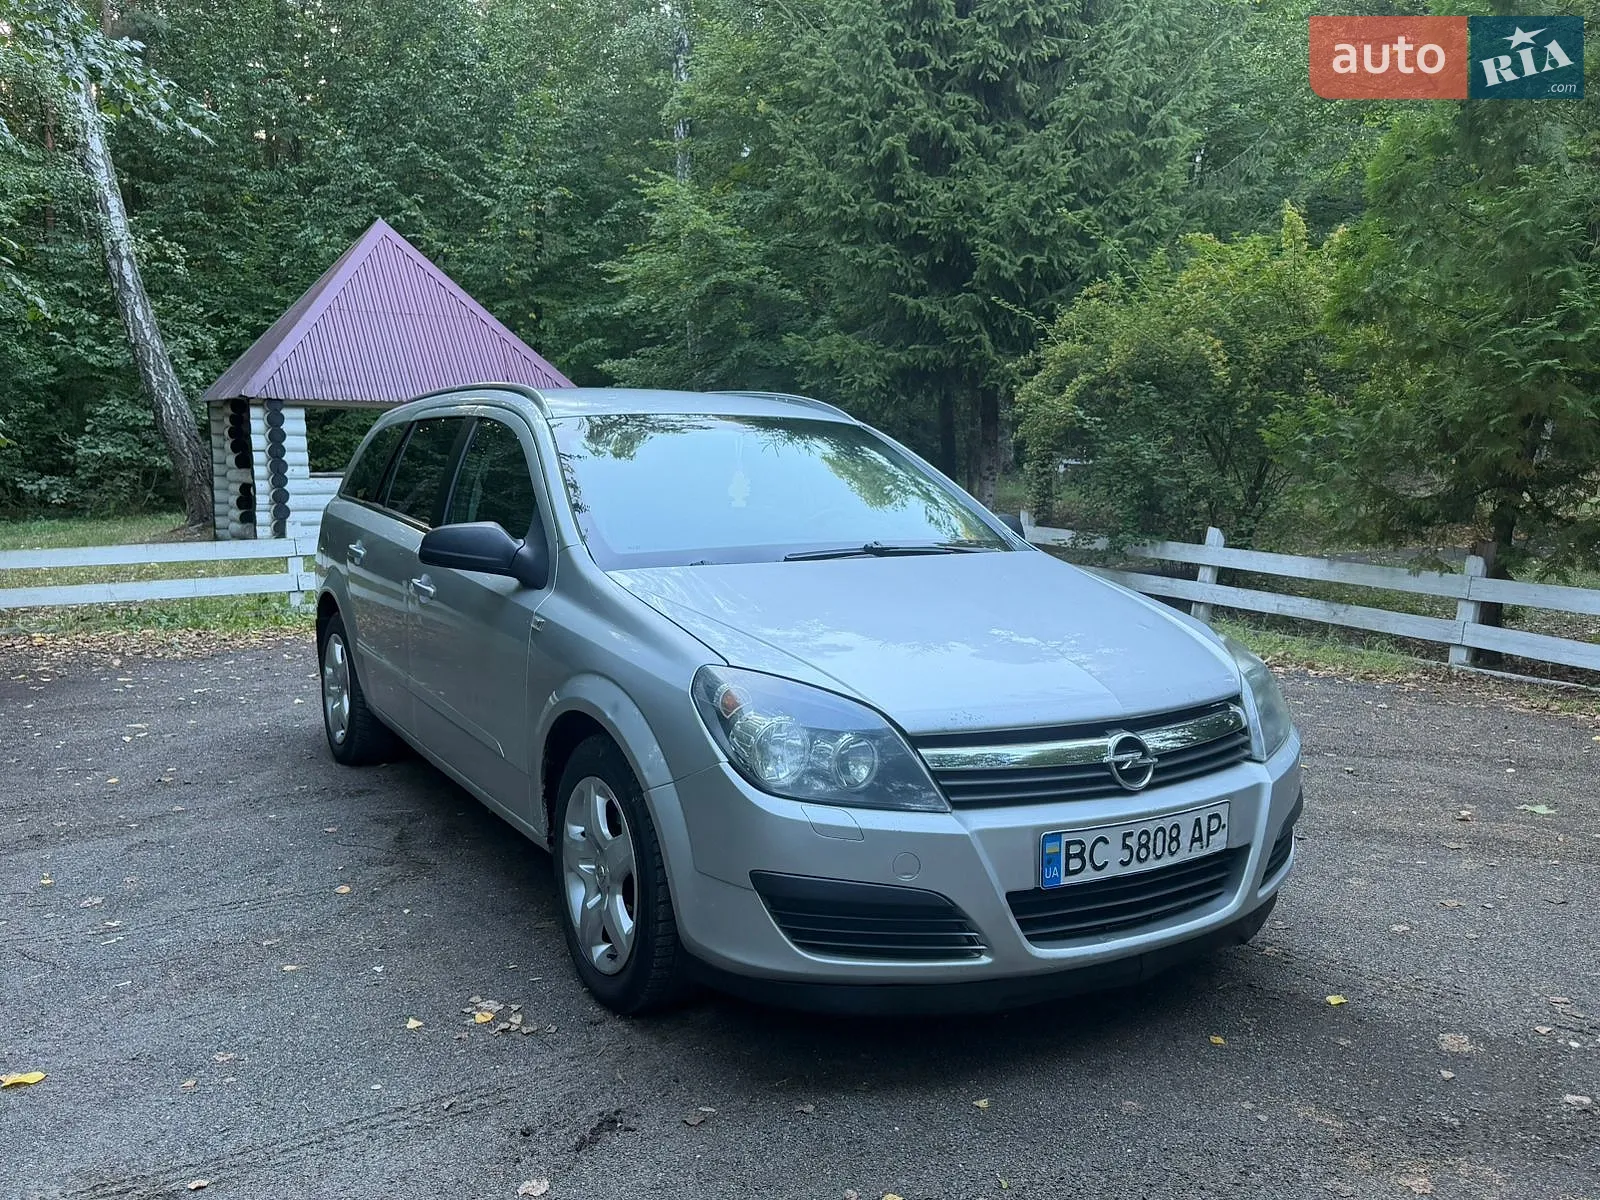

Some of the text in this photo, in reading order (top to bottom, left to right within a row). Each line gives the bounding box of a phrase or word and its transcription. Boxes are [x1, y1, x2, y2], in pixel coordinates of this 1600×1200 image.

[1065, 812, 1222, 876] BC 5808 AP
[1045, 868, 1059, 879] UA
